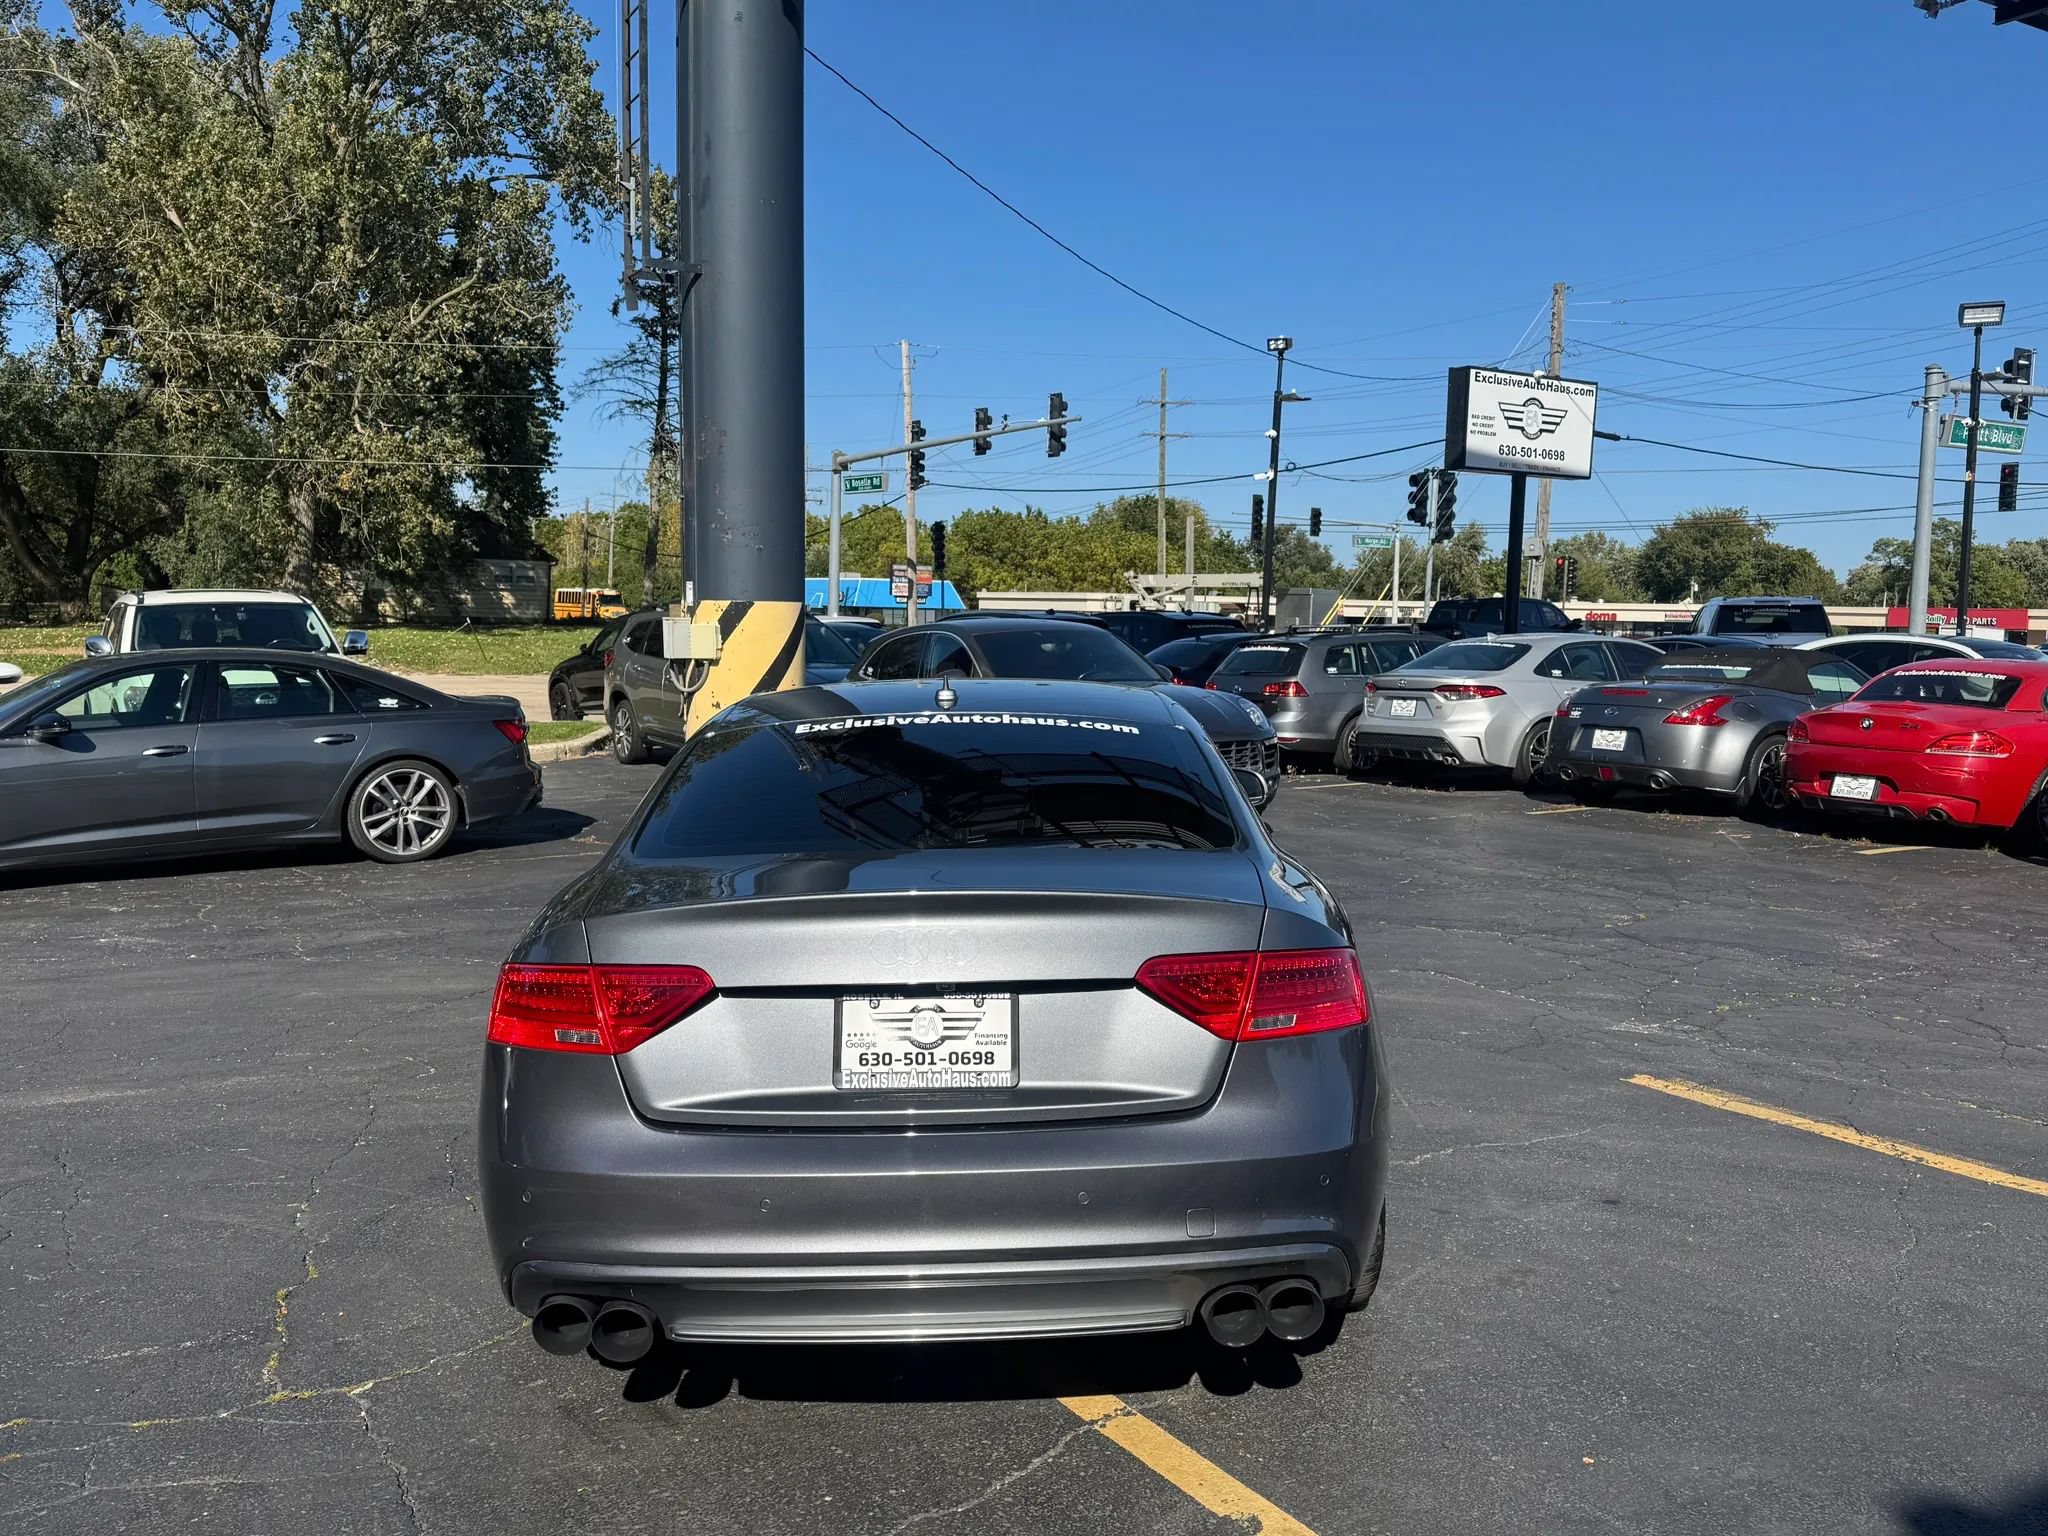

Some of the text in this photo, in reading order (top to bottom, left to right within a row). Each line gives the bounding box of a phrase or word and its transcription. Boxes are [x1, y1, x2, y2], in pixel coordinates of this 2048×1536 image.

[1474, 371, 1594, 398] ExclusiveAutoHaus.com
[1963, 427, 1989, 441] Ptt
[1991, 429, 2014, 444] Blvd
[1498, 444, 1566, 462] 630-501-0698
[851, 477, 871, 487] Roselle
[872, 476, 880, 485] Rd
[1972, 616, 1997, 626] PARTS
[795, 714, 1140, 735] ExclusiveAutohaus.com
[974, 1032, 1008, 1040] Financing
[845, 1039, 877, 1051] Google
[858, 1051, 995, 1066] 630-501-0698
[841, 1068, 1011, 1089] ExclusiveAutoHaus.com
